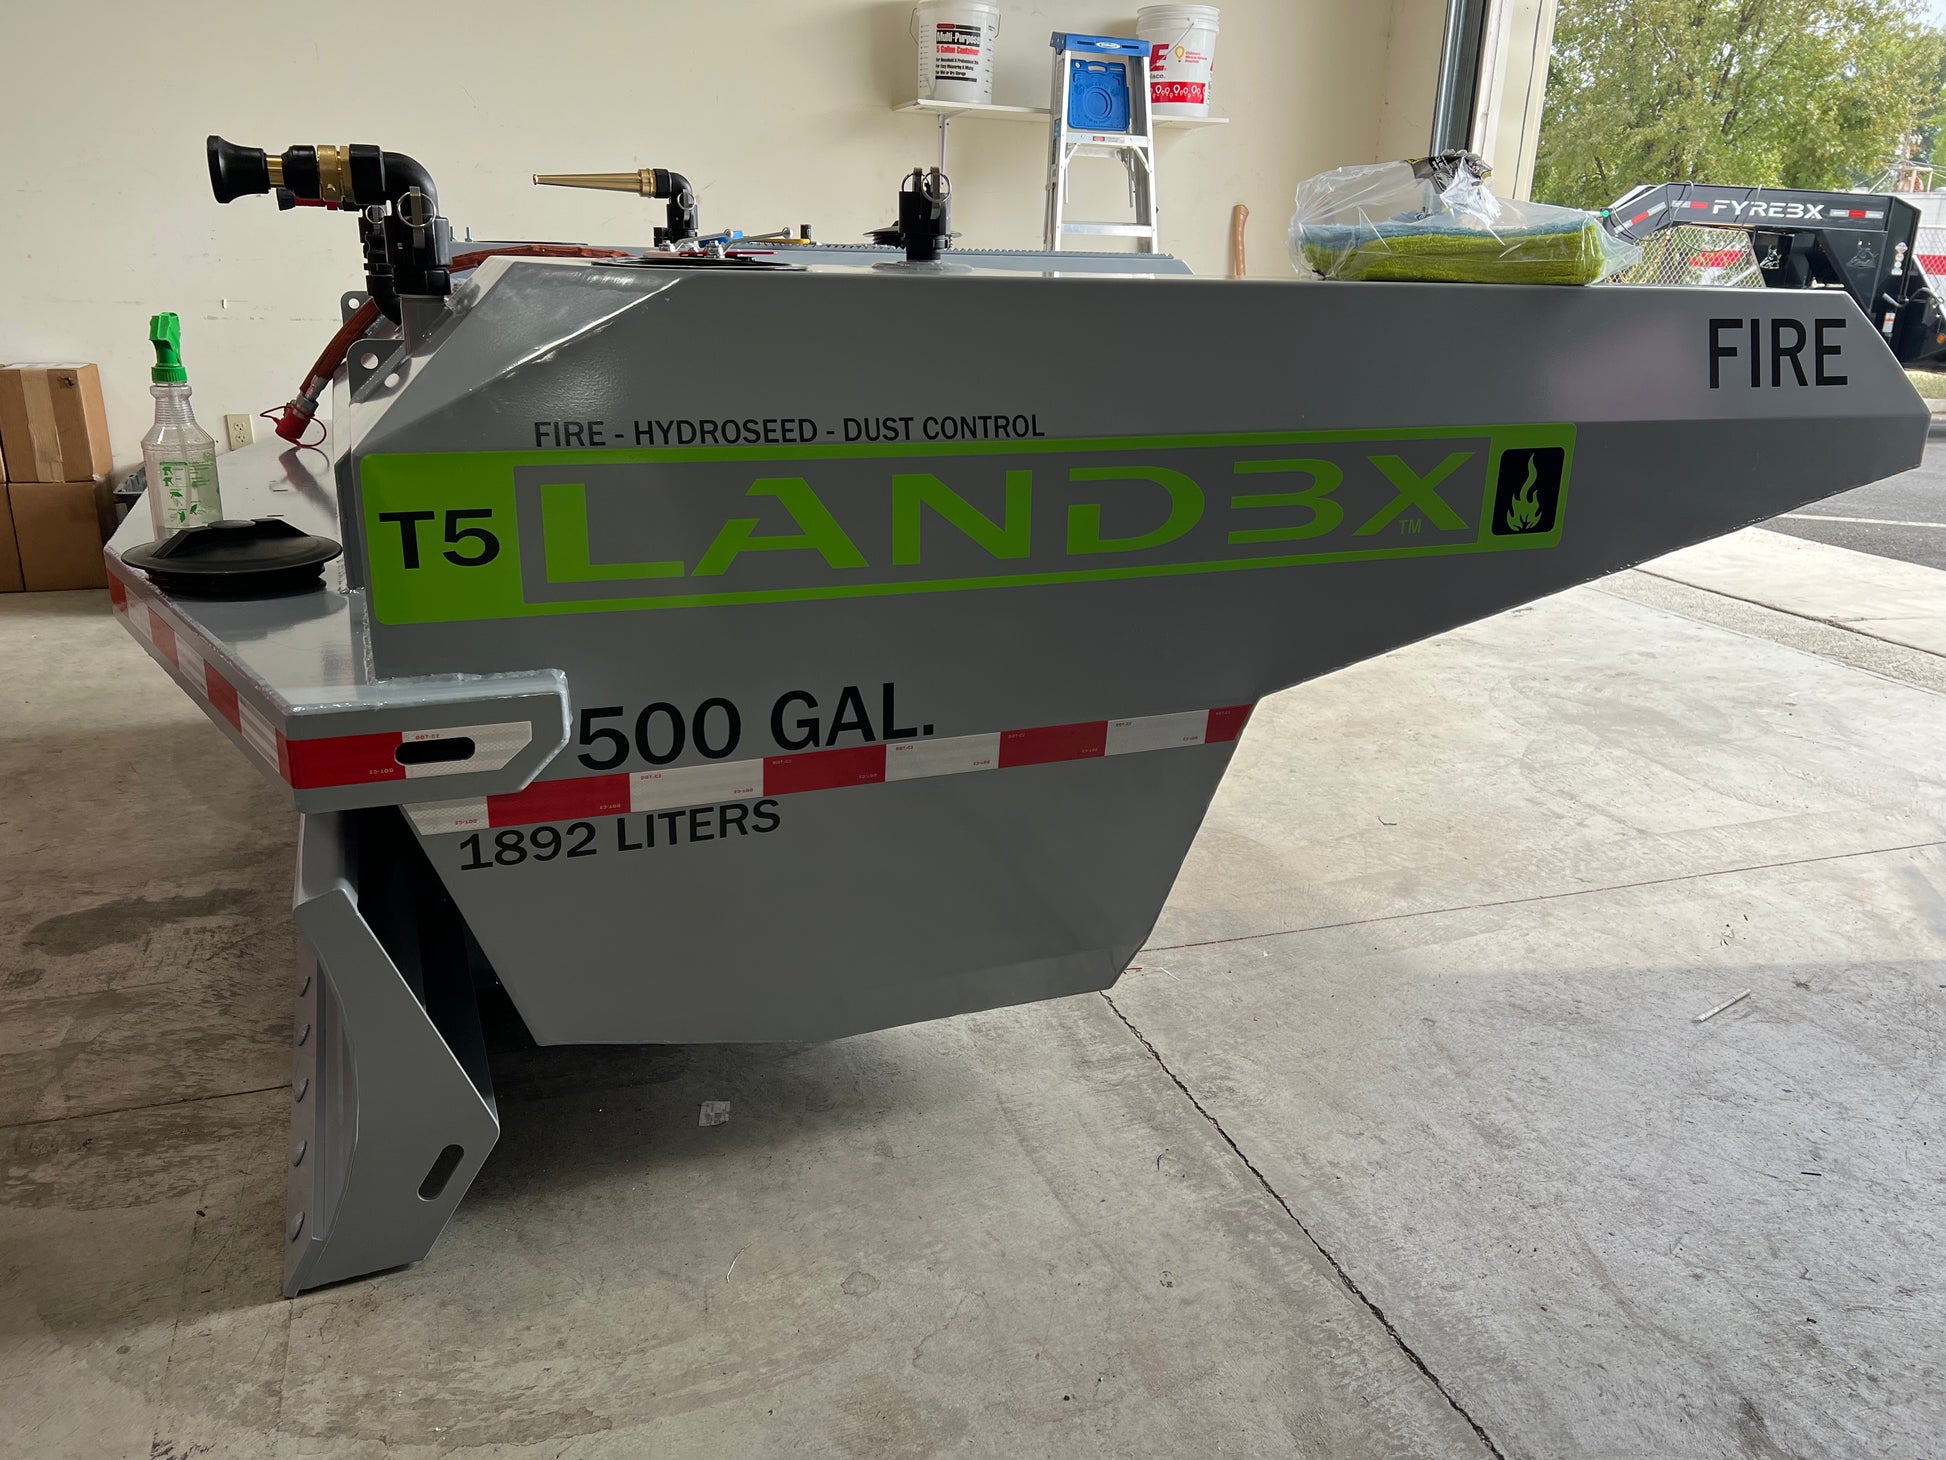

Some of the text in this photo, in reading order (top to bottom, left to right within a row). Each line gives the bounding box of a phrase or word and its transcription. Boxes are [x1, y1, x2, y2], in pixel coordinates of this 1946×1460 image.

[936, 31, 980, 45] Multi-Purpose
[1708, 318, 1848, 389] FIRE
[534, 421, 606, 448] FIRE
[634, 418, 818, 445] HYDROSEED
[843, 417, 914, 442] DUST
[923, 414, 1045, 440] CONTROL
[378, 508, 500, 569] T5
[577, 682, 934, 771] 500 GAL.
[460, 799, 781, 871] 1892 LITERS
